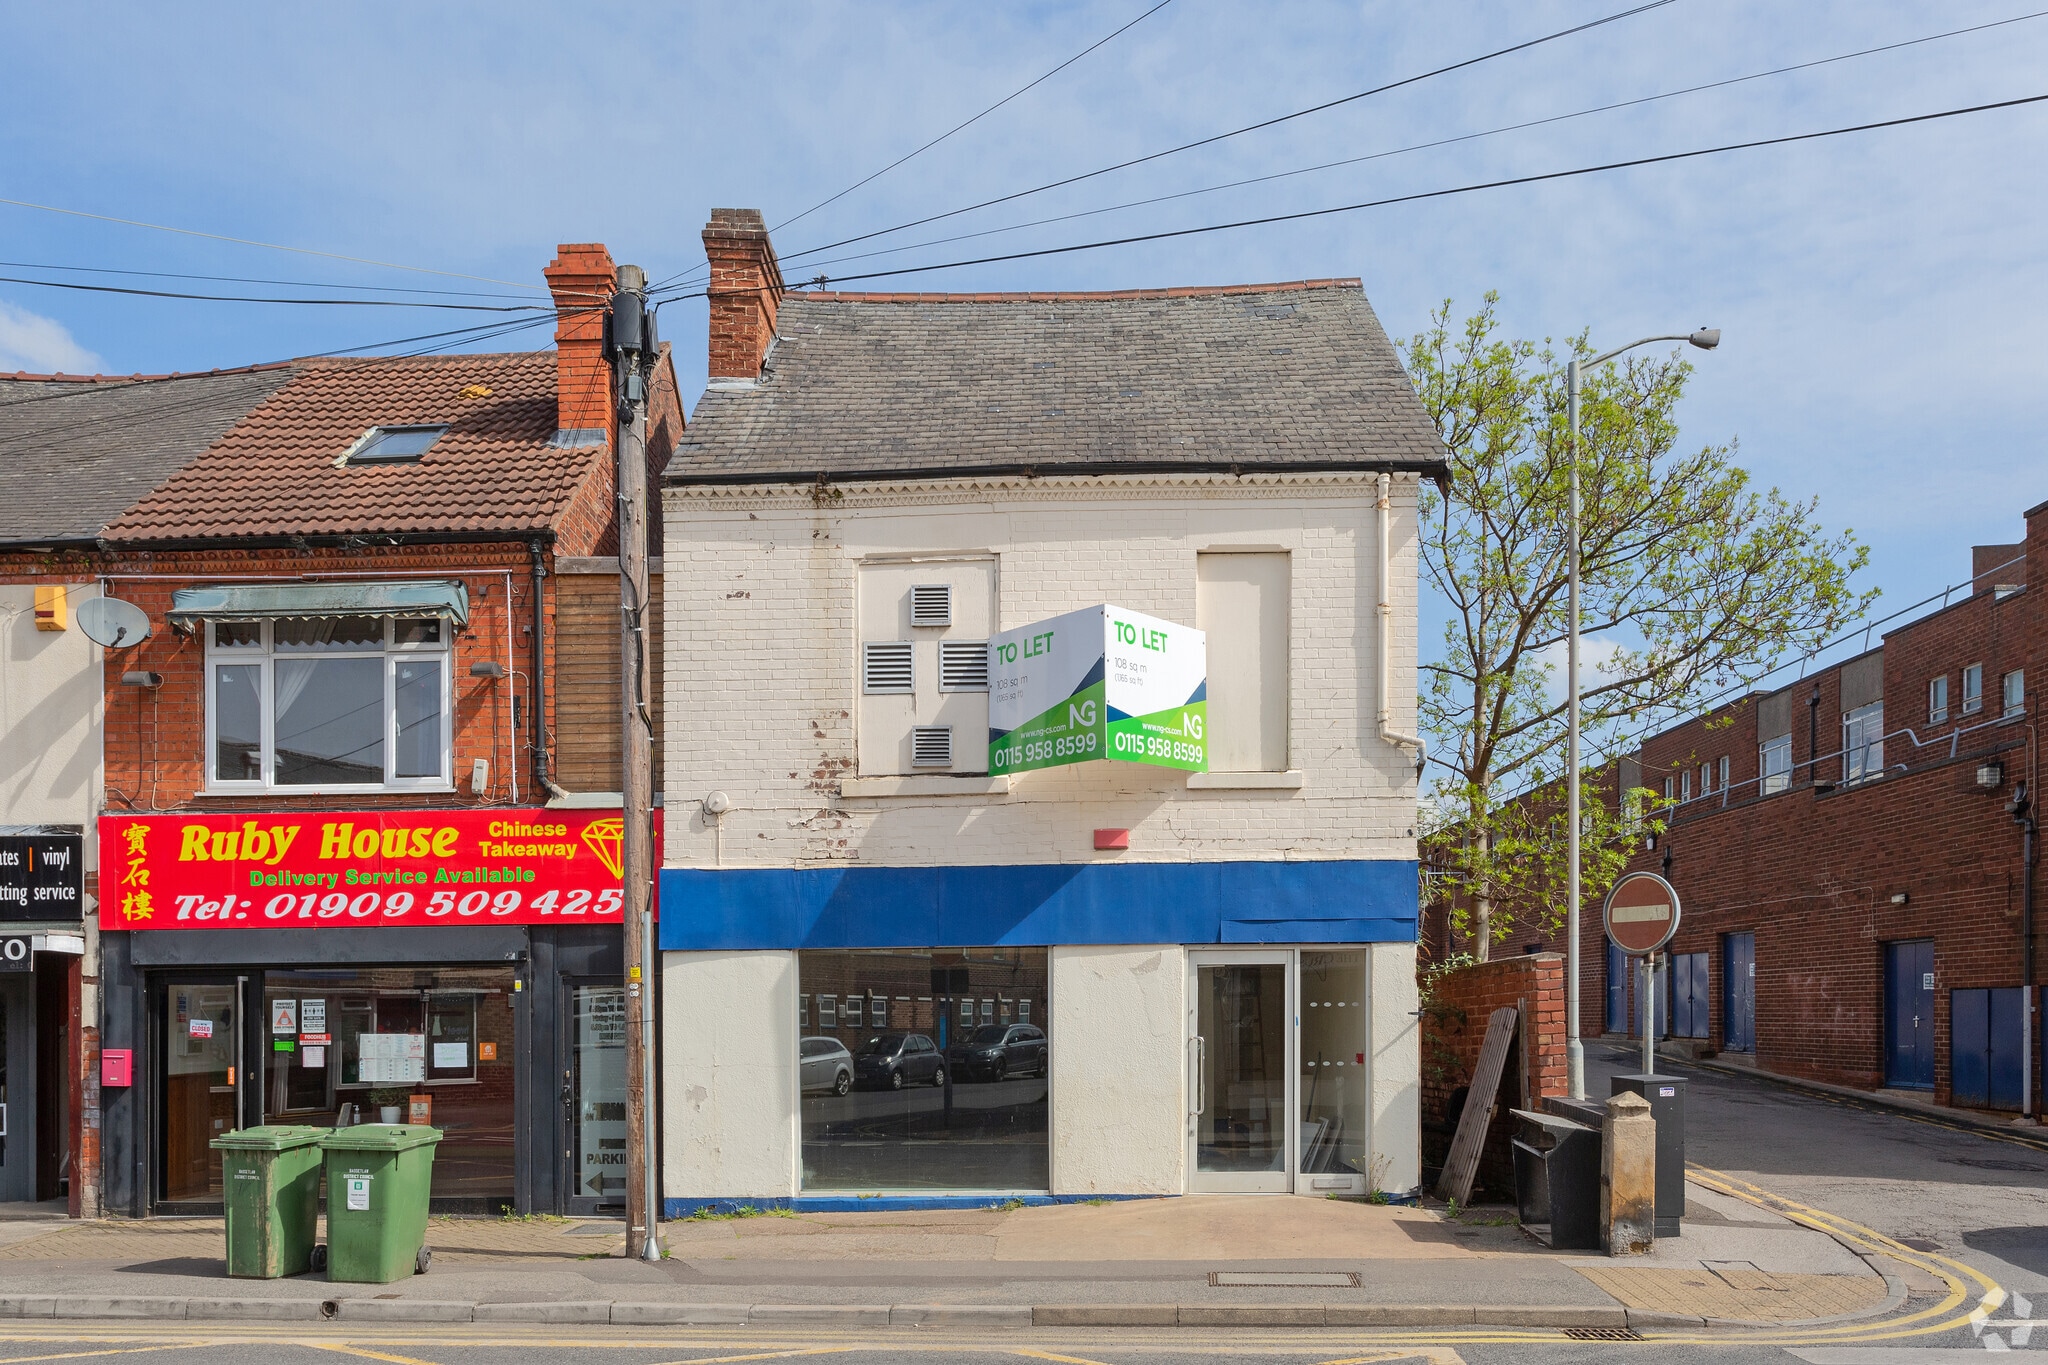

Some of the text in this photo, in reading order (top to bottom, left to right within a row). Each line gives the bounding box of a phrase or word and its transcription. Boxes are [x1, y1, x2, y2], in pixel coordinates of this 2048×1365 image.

[1114, 620, 1168, 653] TO LET
[997, 631, 1055, 666] TO LET
[1114, 657, 1148, 674] 108 sq m
[996, 675, 1028, 690] 108 sq m
[1129, 676, 1137, 685] sq
[1069, 700, 1097, 730] NG
[1183, 712, 1202, 740] NG
[1020, 724, 1067, 739] www.ng-cs.com
[1142, 721, 1182, 737] www.ng-cs.com
[994, 733, 1097, 768] 0115 958 8599
[1115, 731, 1203, 764] 0115 958 8599
[488, 821, 567, 838] Chinese
[178, 821, 460, 865] Ruby House
[478, 841, 577, 860] Takeaway
[42, 846, 70, 871] vinyl
[249, 866, 536, 889] Delivery Service Available
[33, 881, 76, 900] service
[174, 888, 624, 920] Tel: 01909 509 425
[586, 1153, 627, 1165] PARKI
